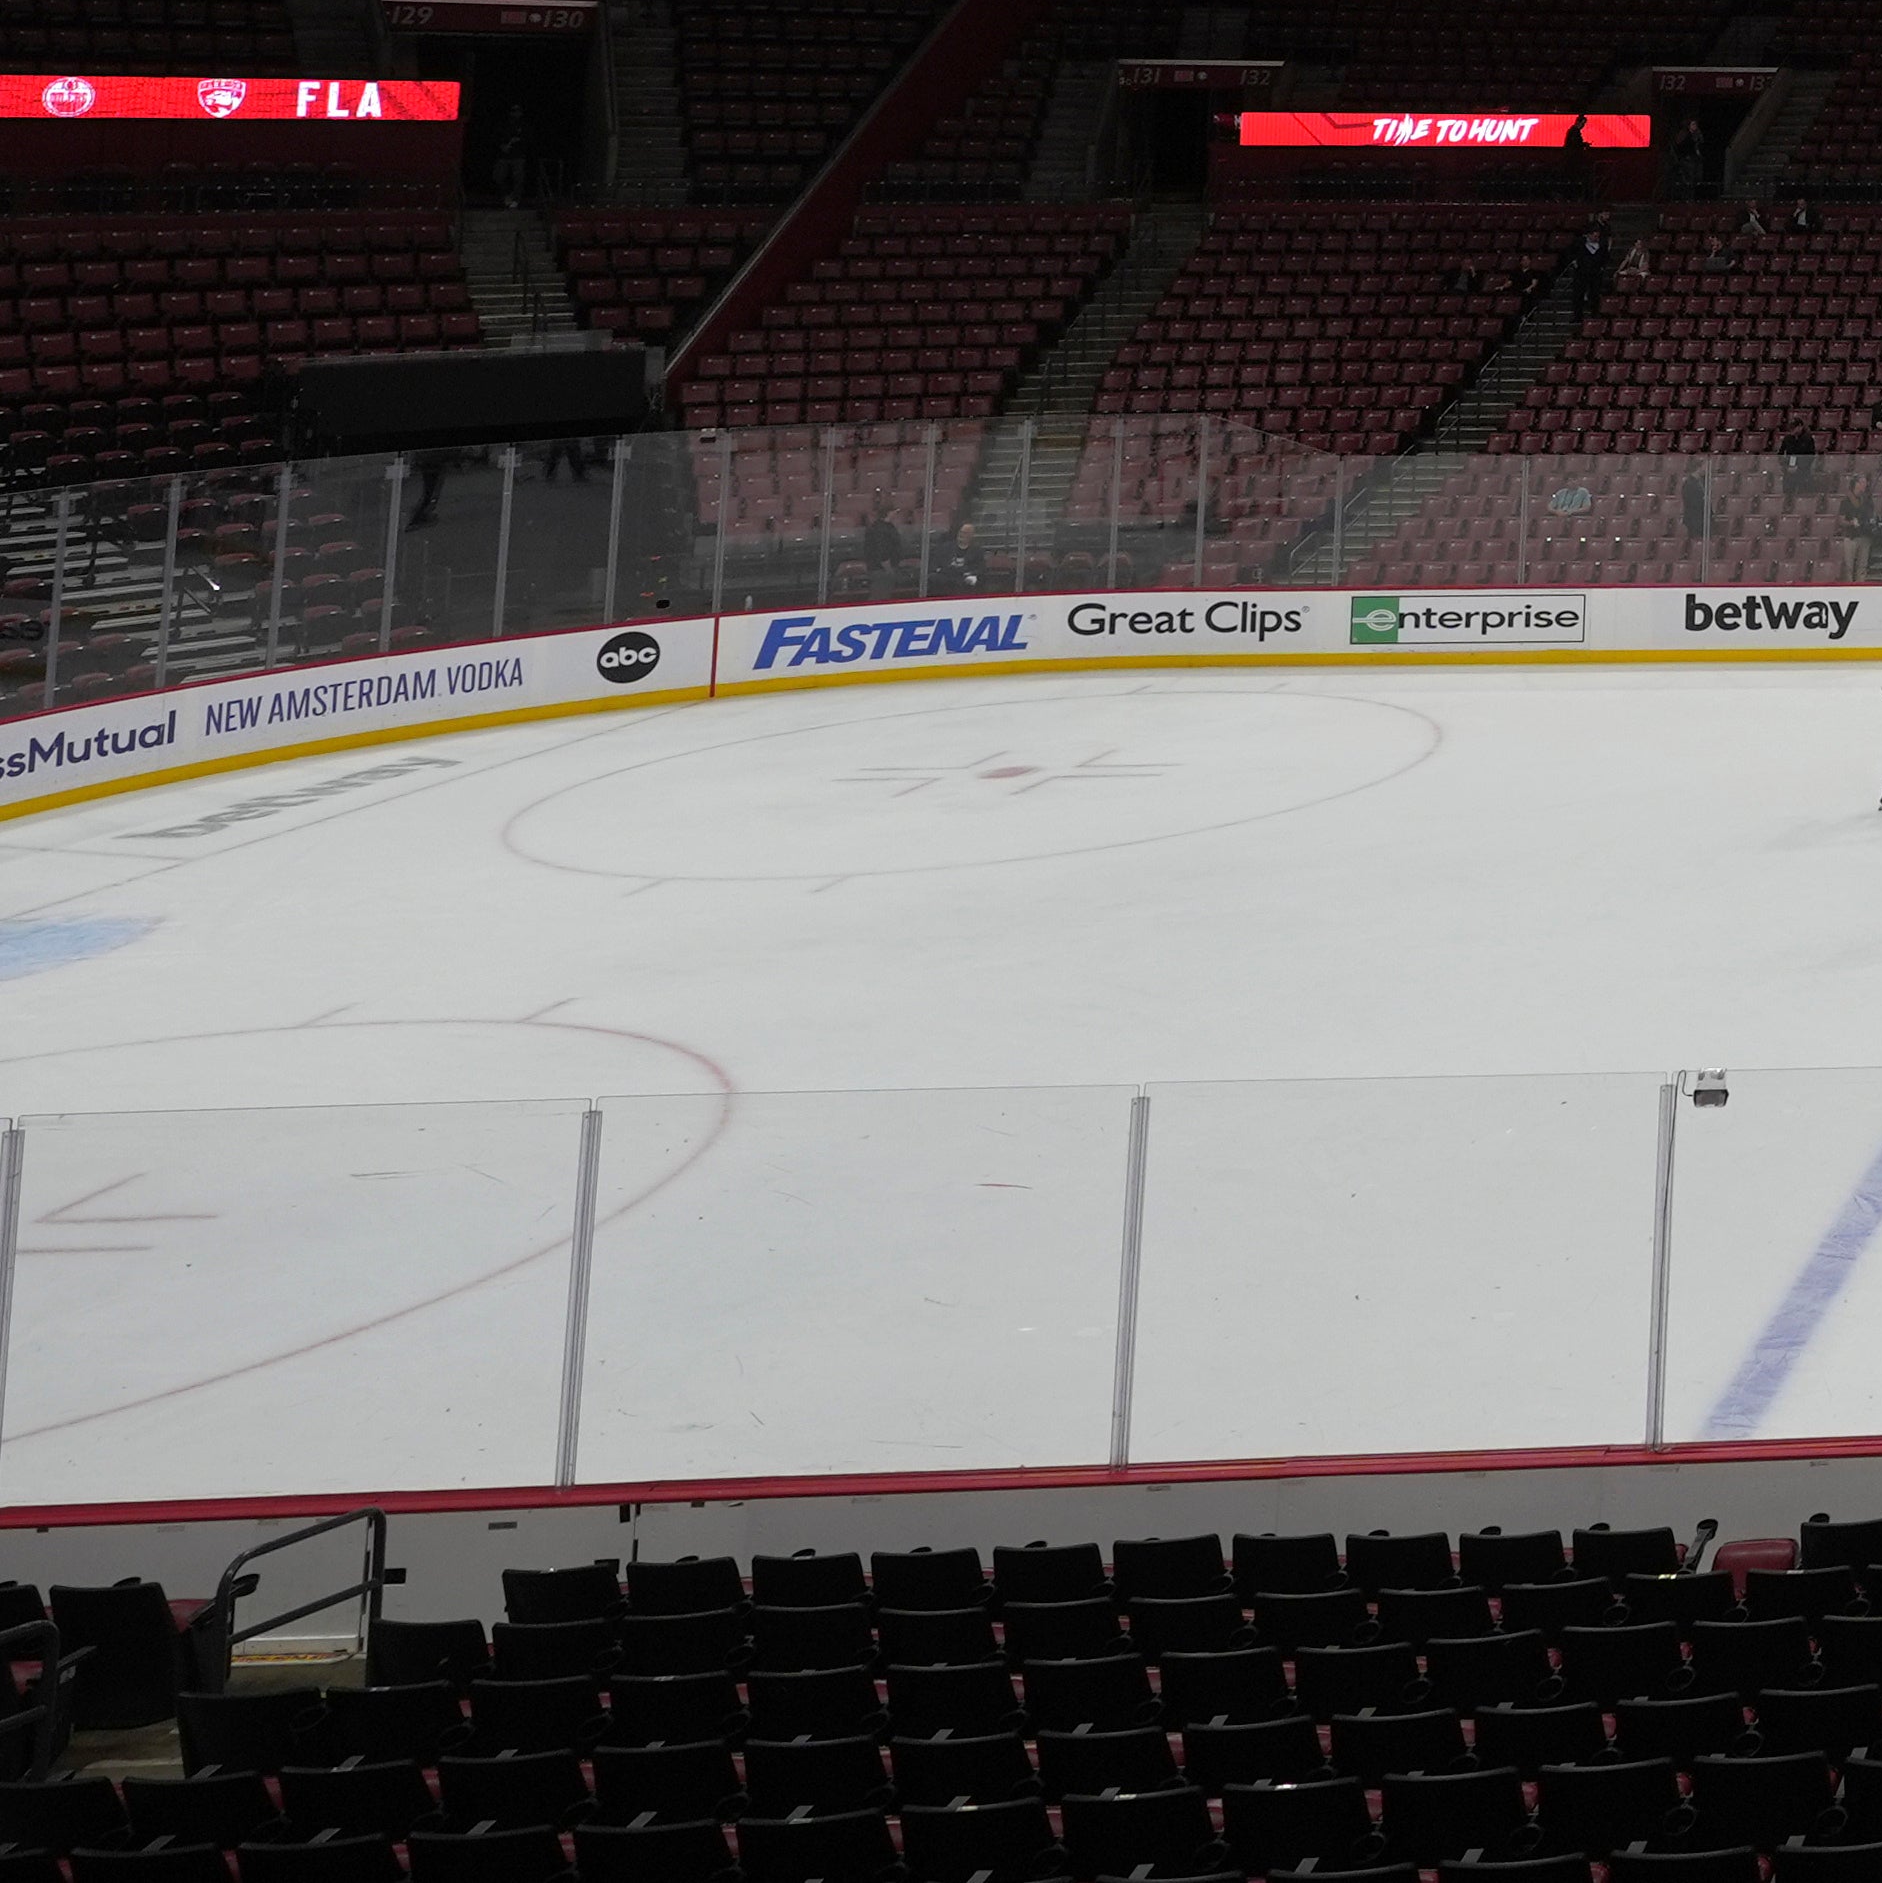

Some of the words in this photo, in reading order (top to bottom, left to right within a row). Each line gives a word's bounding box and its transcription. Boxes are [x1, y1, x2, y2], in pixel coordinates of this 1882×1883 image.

[296, 80, 382, 118] FLA
[1436, 119, 1469, 144] TO
[1468, 118, 1539, 144] HUNT
[1067, 603, 1196, 636] Great
[1204, 600, 1302, 642] Clips
[1355, 604, 1580, 637] enterprise
[1685, 593, 1859, 640] betway
[599, 640, 659, 672] abc
[753, 615, 1029, 670] FASTENAL
[205, 696, 264, 737] NEW
[267, 669, 437, 726] AMSTERDAM
[445, 657, 524, 696] VODKA
